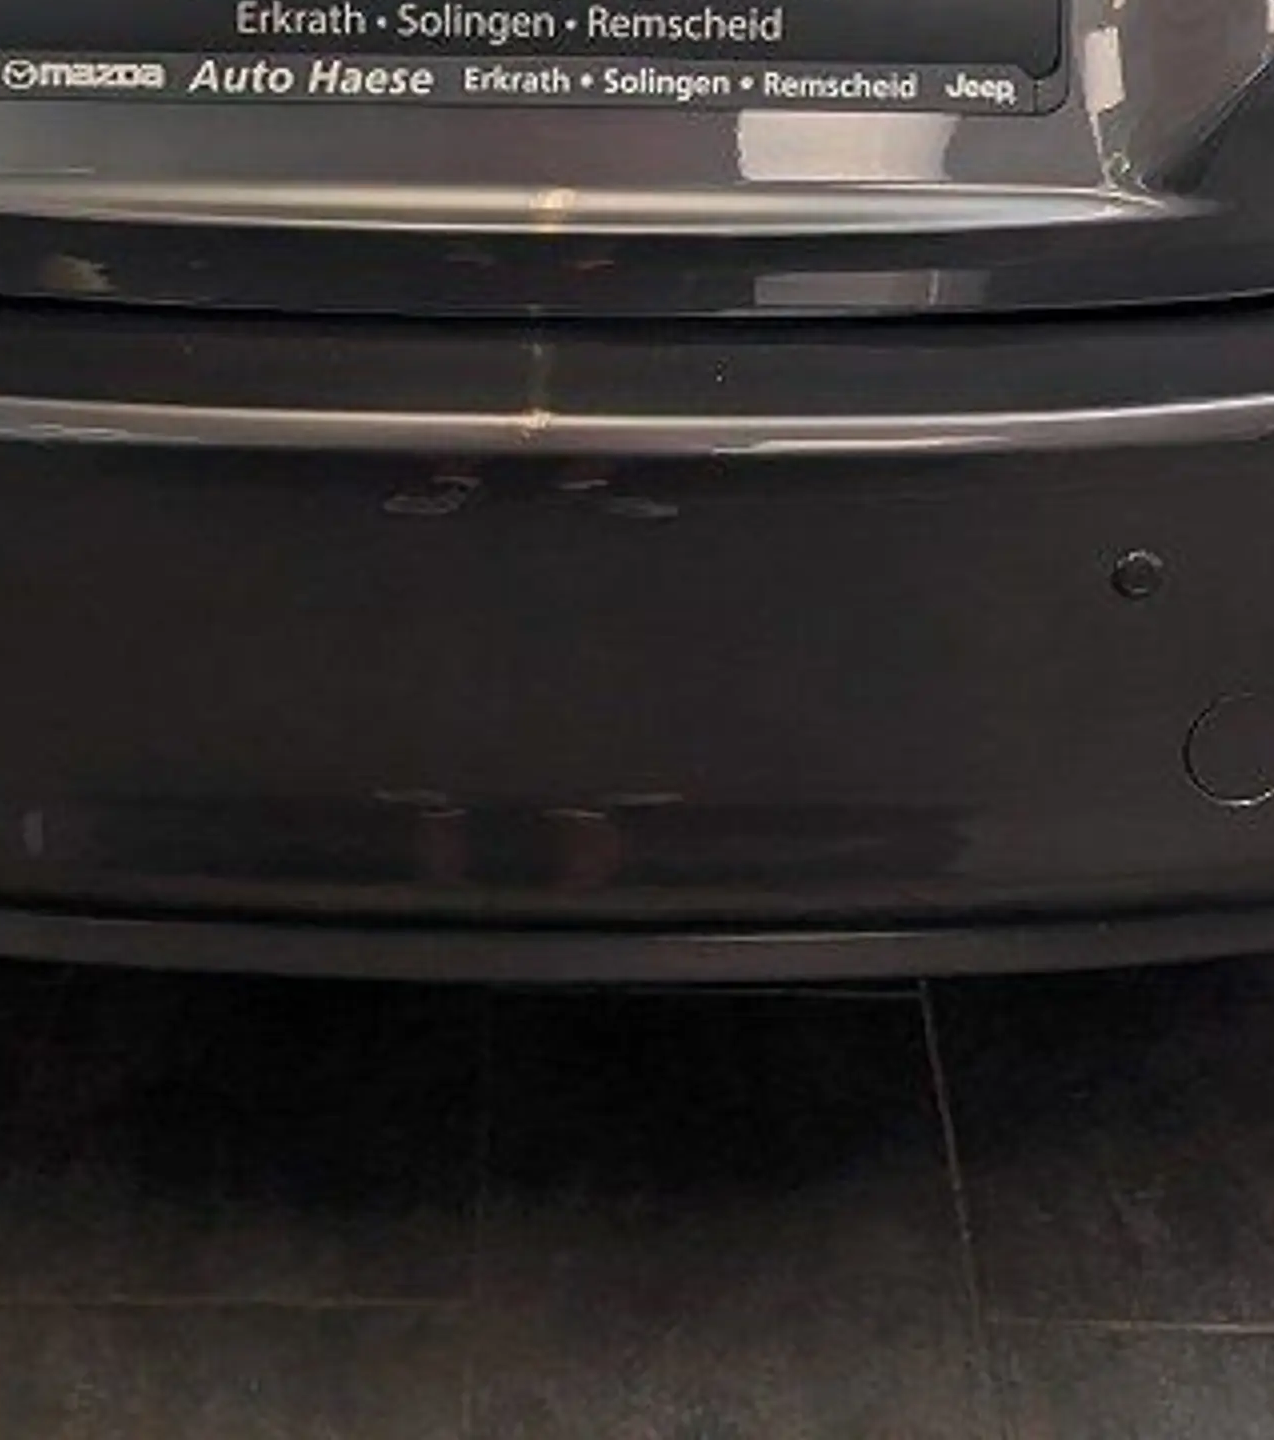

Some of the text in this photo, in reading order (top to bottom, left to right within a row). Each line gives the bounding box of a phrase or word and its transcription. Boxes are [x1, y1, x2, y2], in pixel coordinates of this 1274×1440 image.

[236, 0, 783, 45] Erkrath Solingen Remscheid
[187, 59, 293, 94] Auto
[308, 61, 435, 95] Haese
[463, 66, 572, 94] Erkrath
[603, 68, 731, 101] Solingen
[763, 70, 917, 100] Remscheid
[945, 73, 1017, 106] Jeep
